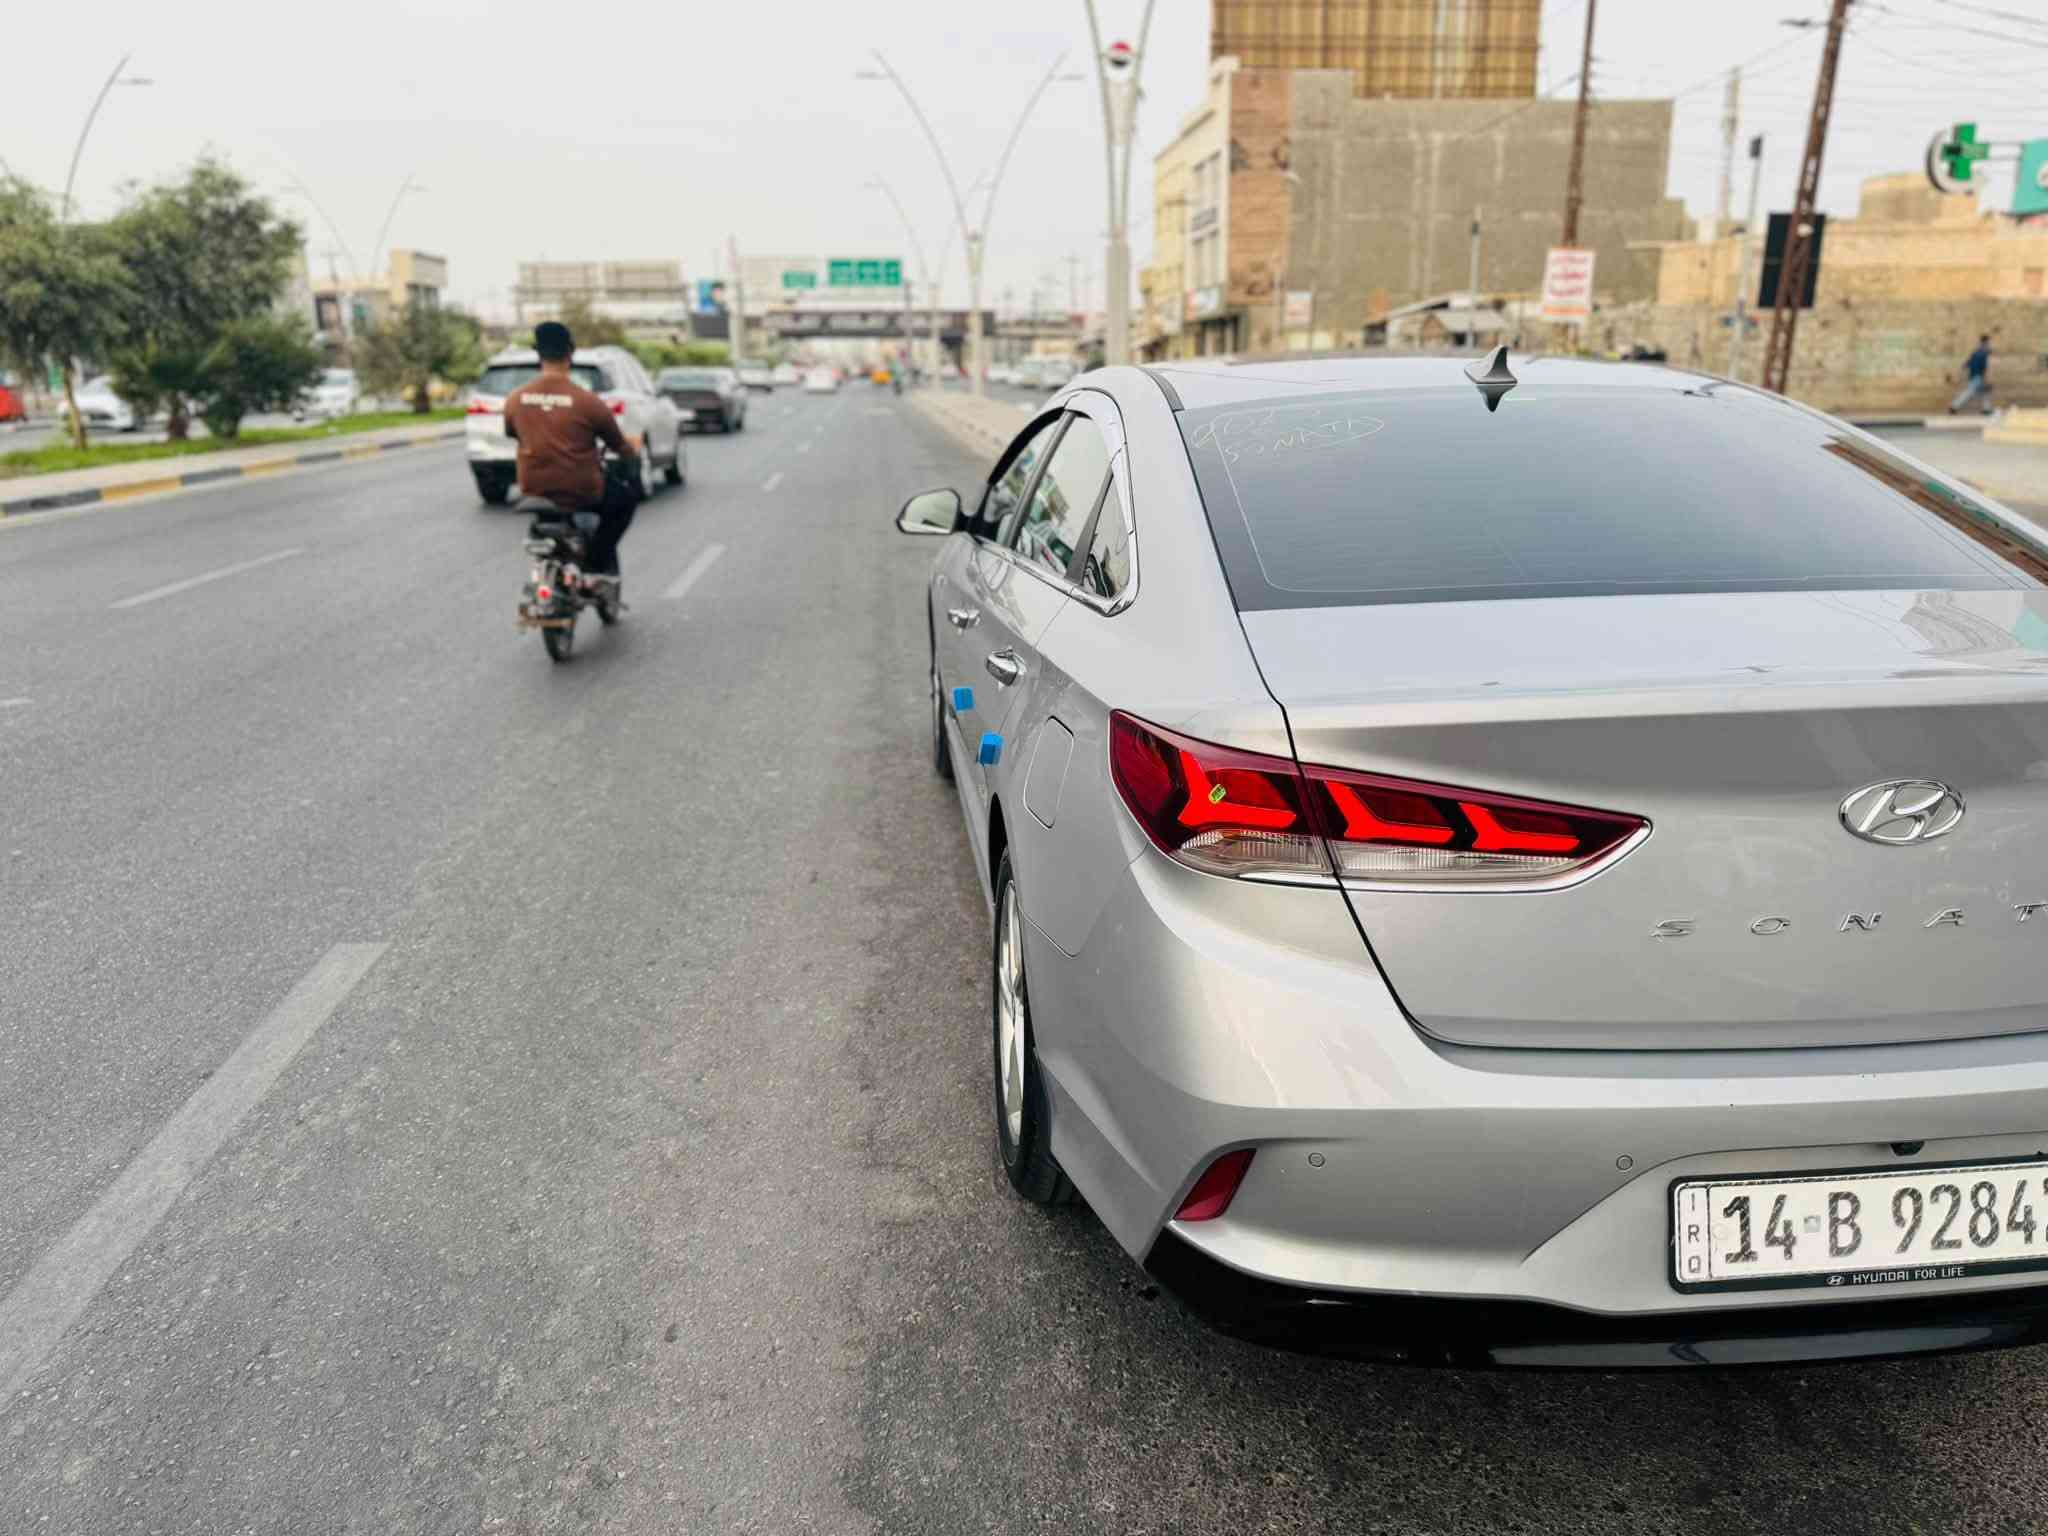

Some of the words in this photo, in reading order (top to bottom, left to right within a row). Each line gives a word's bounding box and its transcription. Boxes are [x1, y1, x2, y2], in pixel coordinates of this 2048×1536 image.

[1722, 1194, 1797, 1265] 14
[1827, 1191, 1863, 1258] B
[1891, 1177, 2048, 1254] 9284
[1853, 1271, 1910, 1284] HYUNDAI
[1914, 1269, 1937, 1280] FOR
[1941, 1267, 1965, 1278] LIFE
